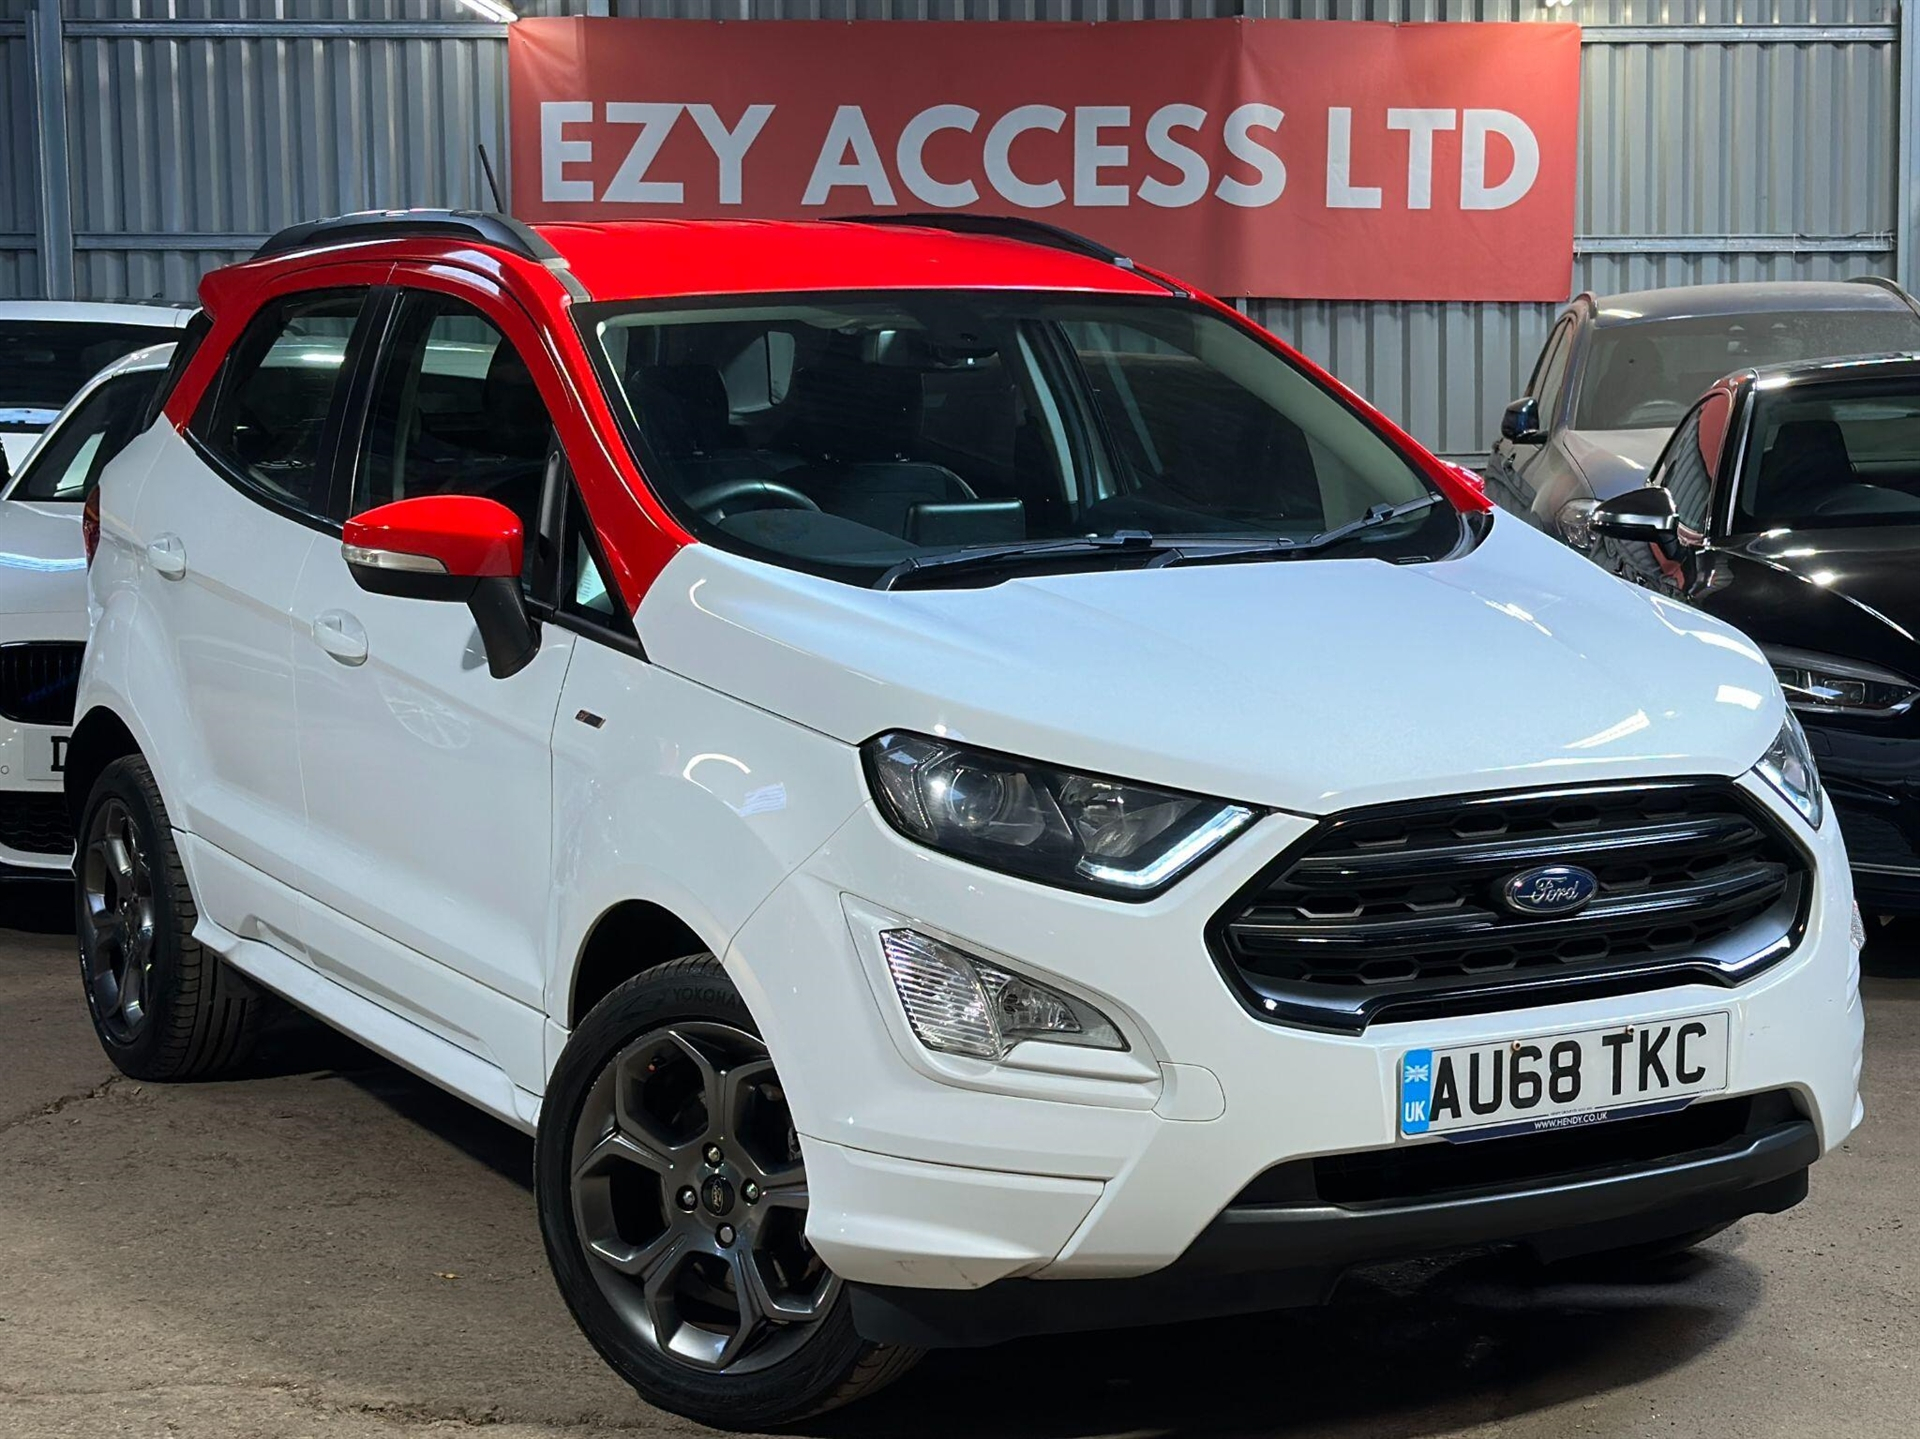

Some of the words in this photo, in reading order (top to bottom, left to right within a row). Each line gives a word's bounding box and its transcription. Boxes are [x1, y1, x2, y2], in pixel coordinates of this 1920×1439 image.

[540, 101, 776, 204] EZY
[801, 103, 1287, 208] ACCESS
[1326, 106, 1540, 210] LTD
[1516, 876, 1580, 904] Ford
[1429, 1040, 1582, 1122] AU68
[1602, 1021, 1707, 1096] TKC
[1404, 1100, 1427, 1123] UK
[1534, 1111, 1608, 1130] WWW.HENDY.CO.UK
